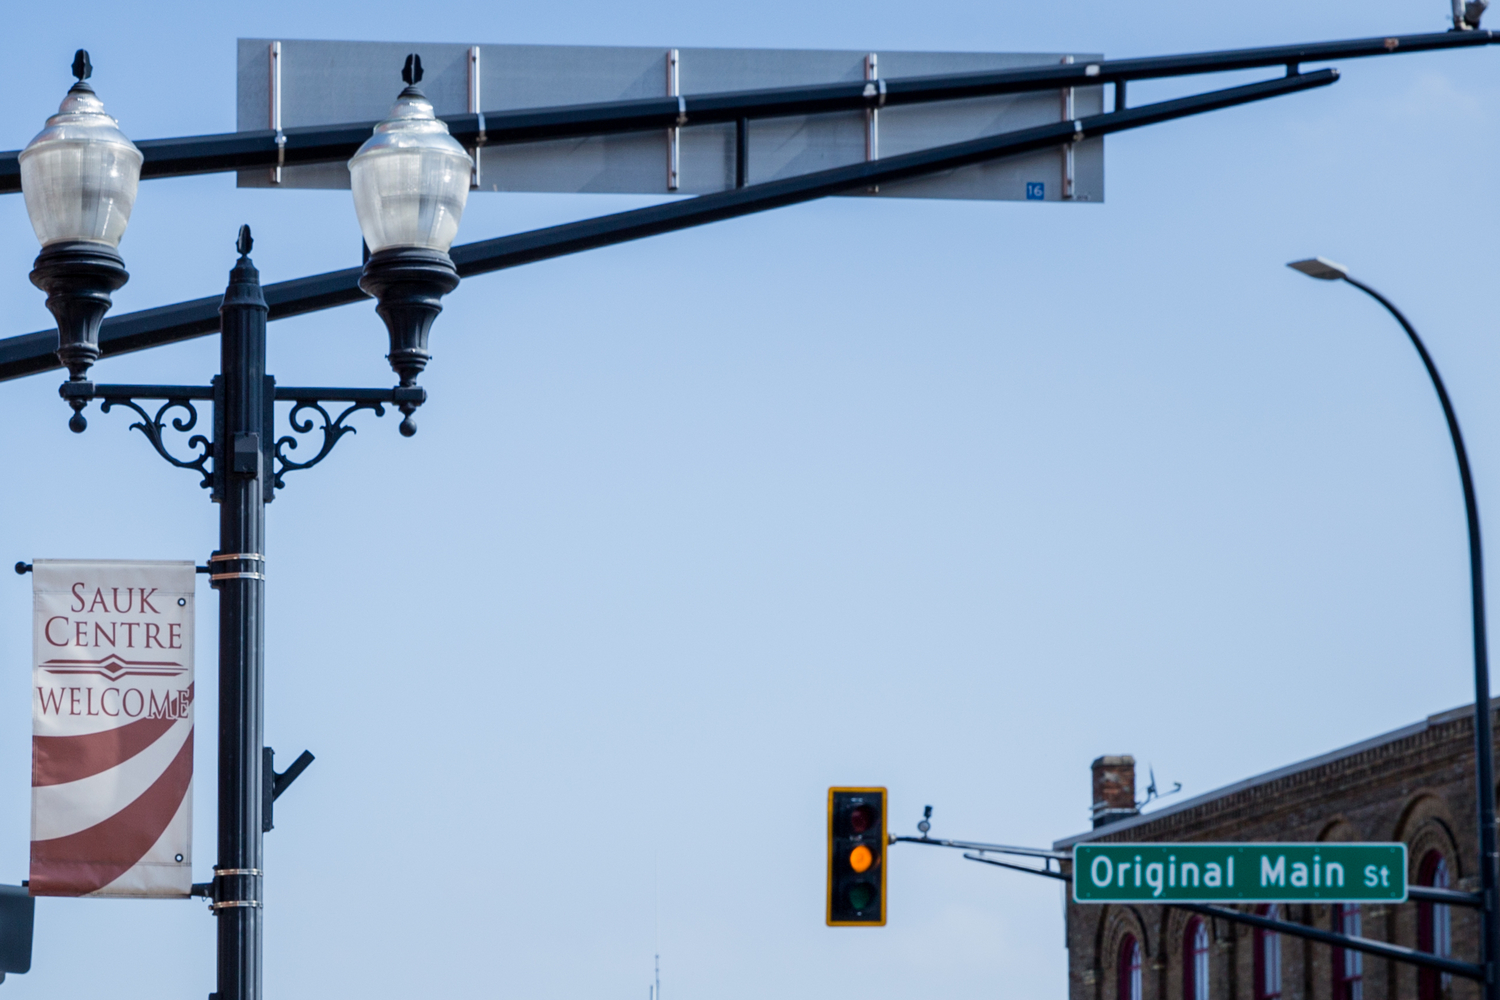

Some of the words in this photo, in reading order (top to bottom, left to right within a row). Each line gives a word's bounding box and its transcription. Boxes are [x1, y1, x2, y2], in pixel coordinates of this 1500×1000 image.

[1028, 185, 1043, 197] 16
[71, 582, 161, 614] SAUK
[44, 615, 183, 649] CENTRE
[36, 686, 189, 719] WELCOME
[1090, 854, 1235, 898] Original
[1260, 854, 1345, 887] Main
[1363, 864, 1390, 887] St
